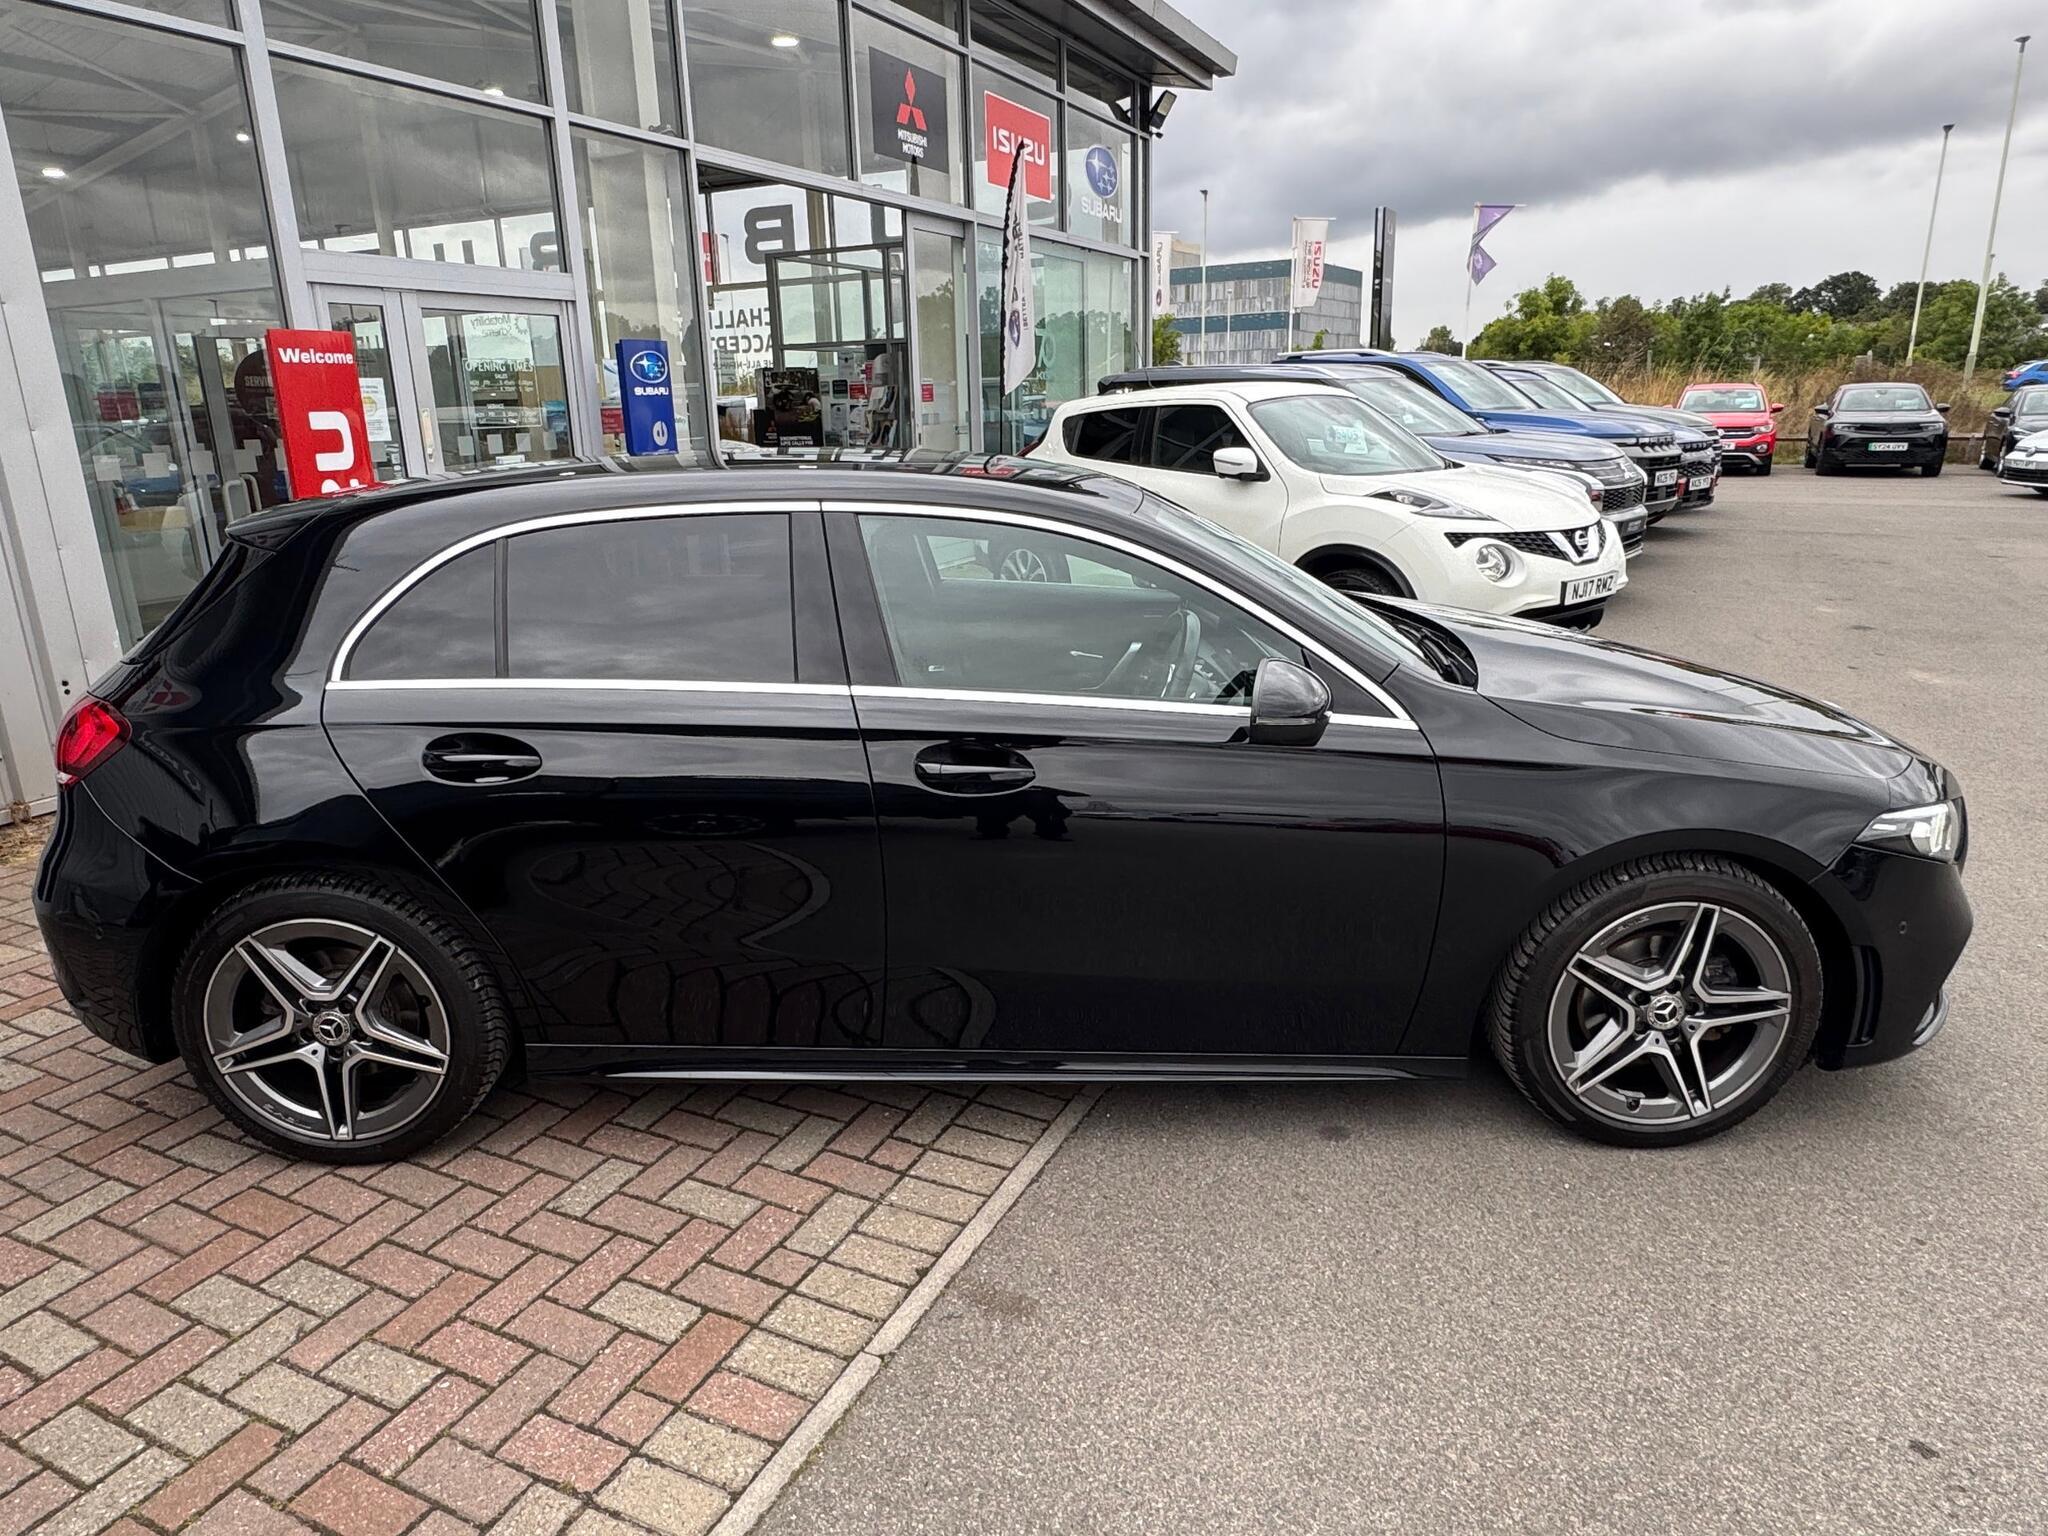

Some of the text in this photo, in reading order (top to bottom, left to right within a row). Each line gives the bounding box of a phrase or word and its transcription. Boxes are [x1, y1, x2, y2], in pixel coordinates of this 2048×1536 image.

[897, 129, 928, 148] MITSUBISHI
[992, 126, 1045, 166] ISUZU
[902, 143, 924, 159] MOTORS
[1080, 196, 1122, 224] SUBARU
[1311, 241, 1322, 289] ISUZU
[278, 347, 354, 364] Welcome
[465, 360, 506, 372] OPENING
[634, 387, 669, 396] SUBARU
[1572, 575, 1614, 600] NJ17 RMZ
